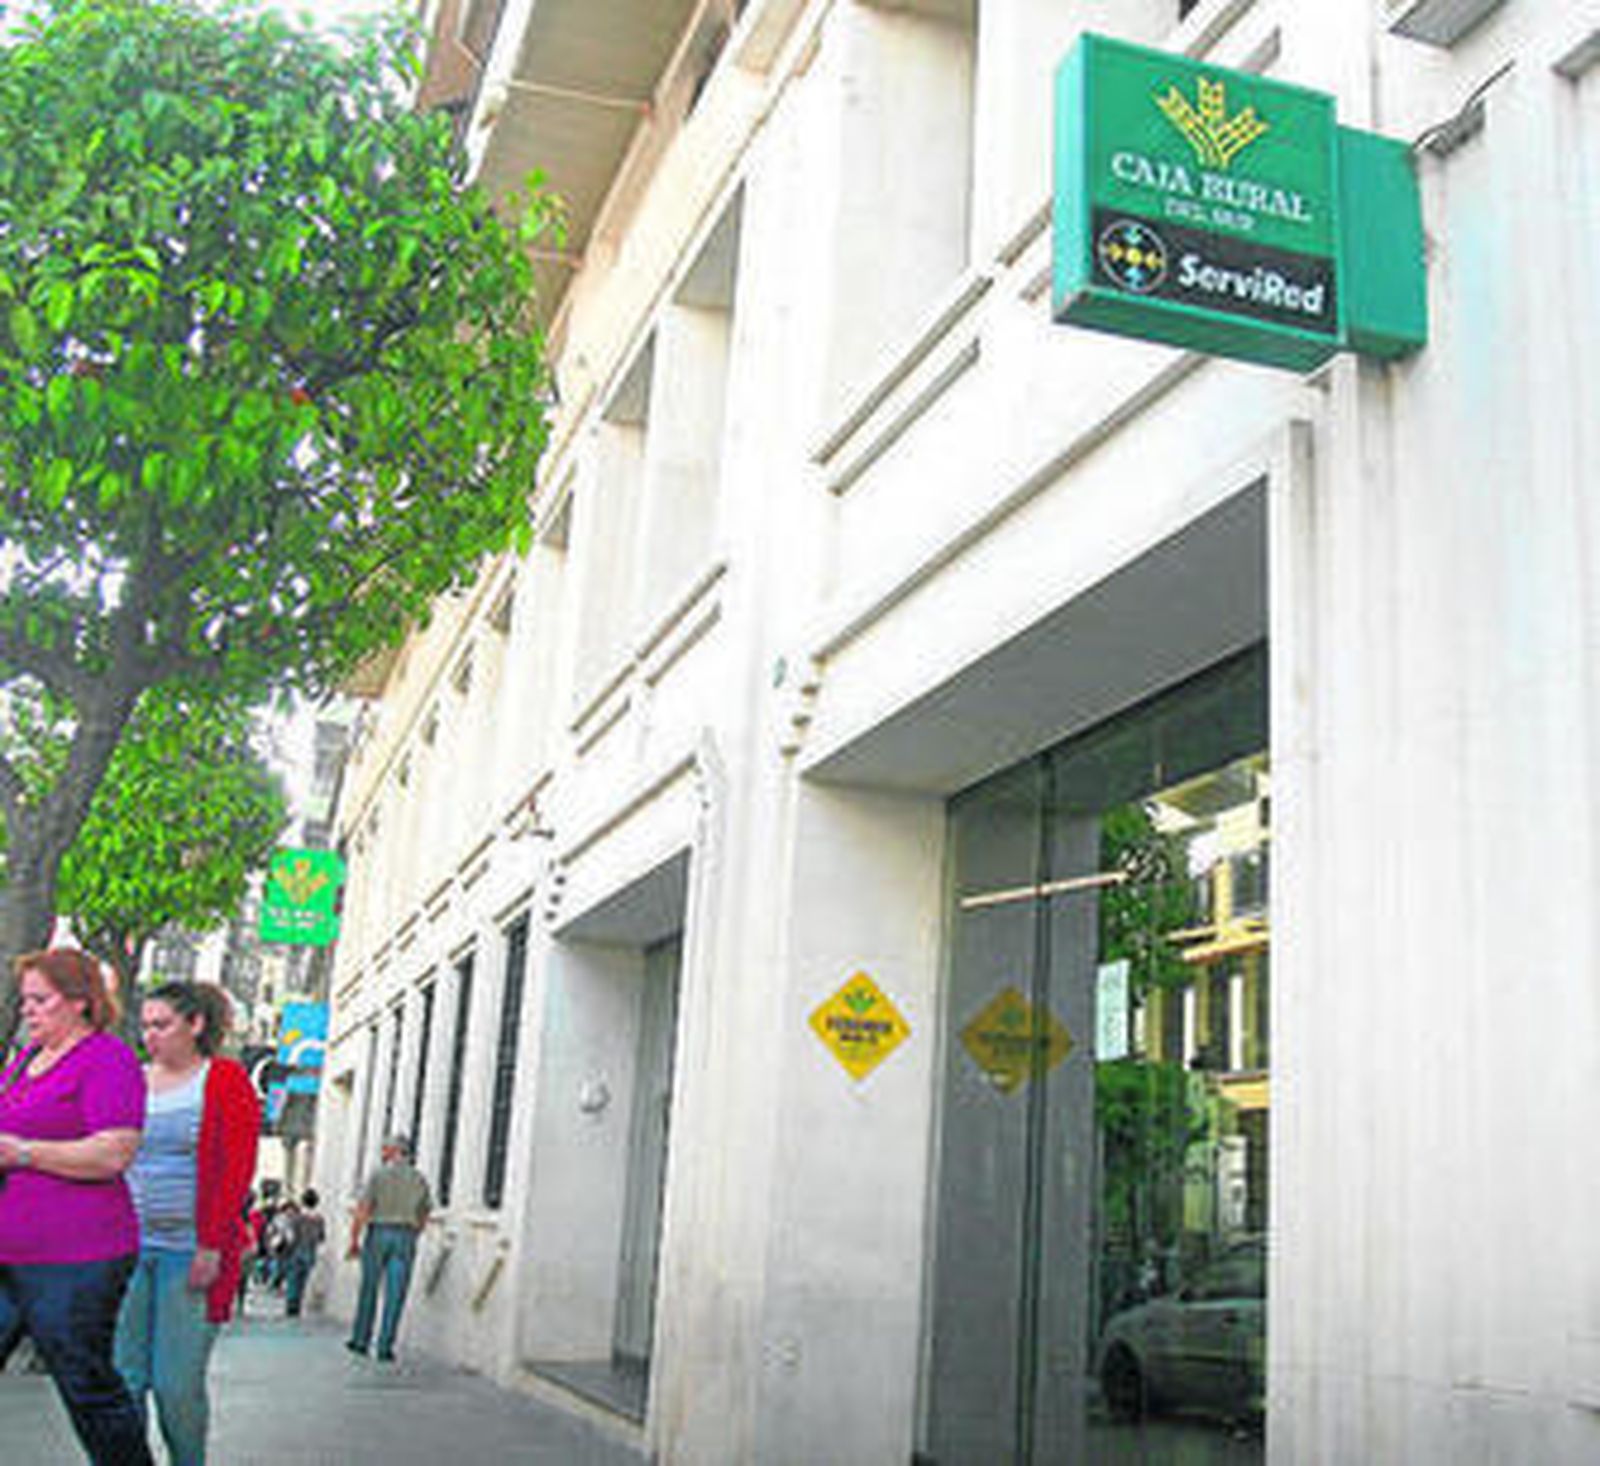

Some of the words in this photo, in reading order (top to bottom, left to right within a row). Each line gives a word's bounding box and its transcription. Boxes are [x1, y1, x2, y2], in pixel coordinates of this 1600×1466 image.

[1112, 152, 1194, 193] CAJA
[1202, 173, 1312, 222] RURAL
[1179, 253, 1324, 313] ServiRed
